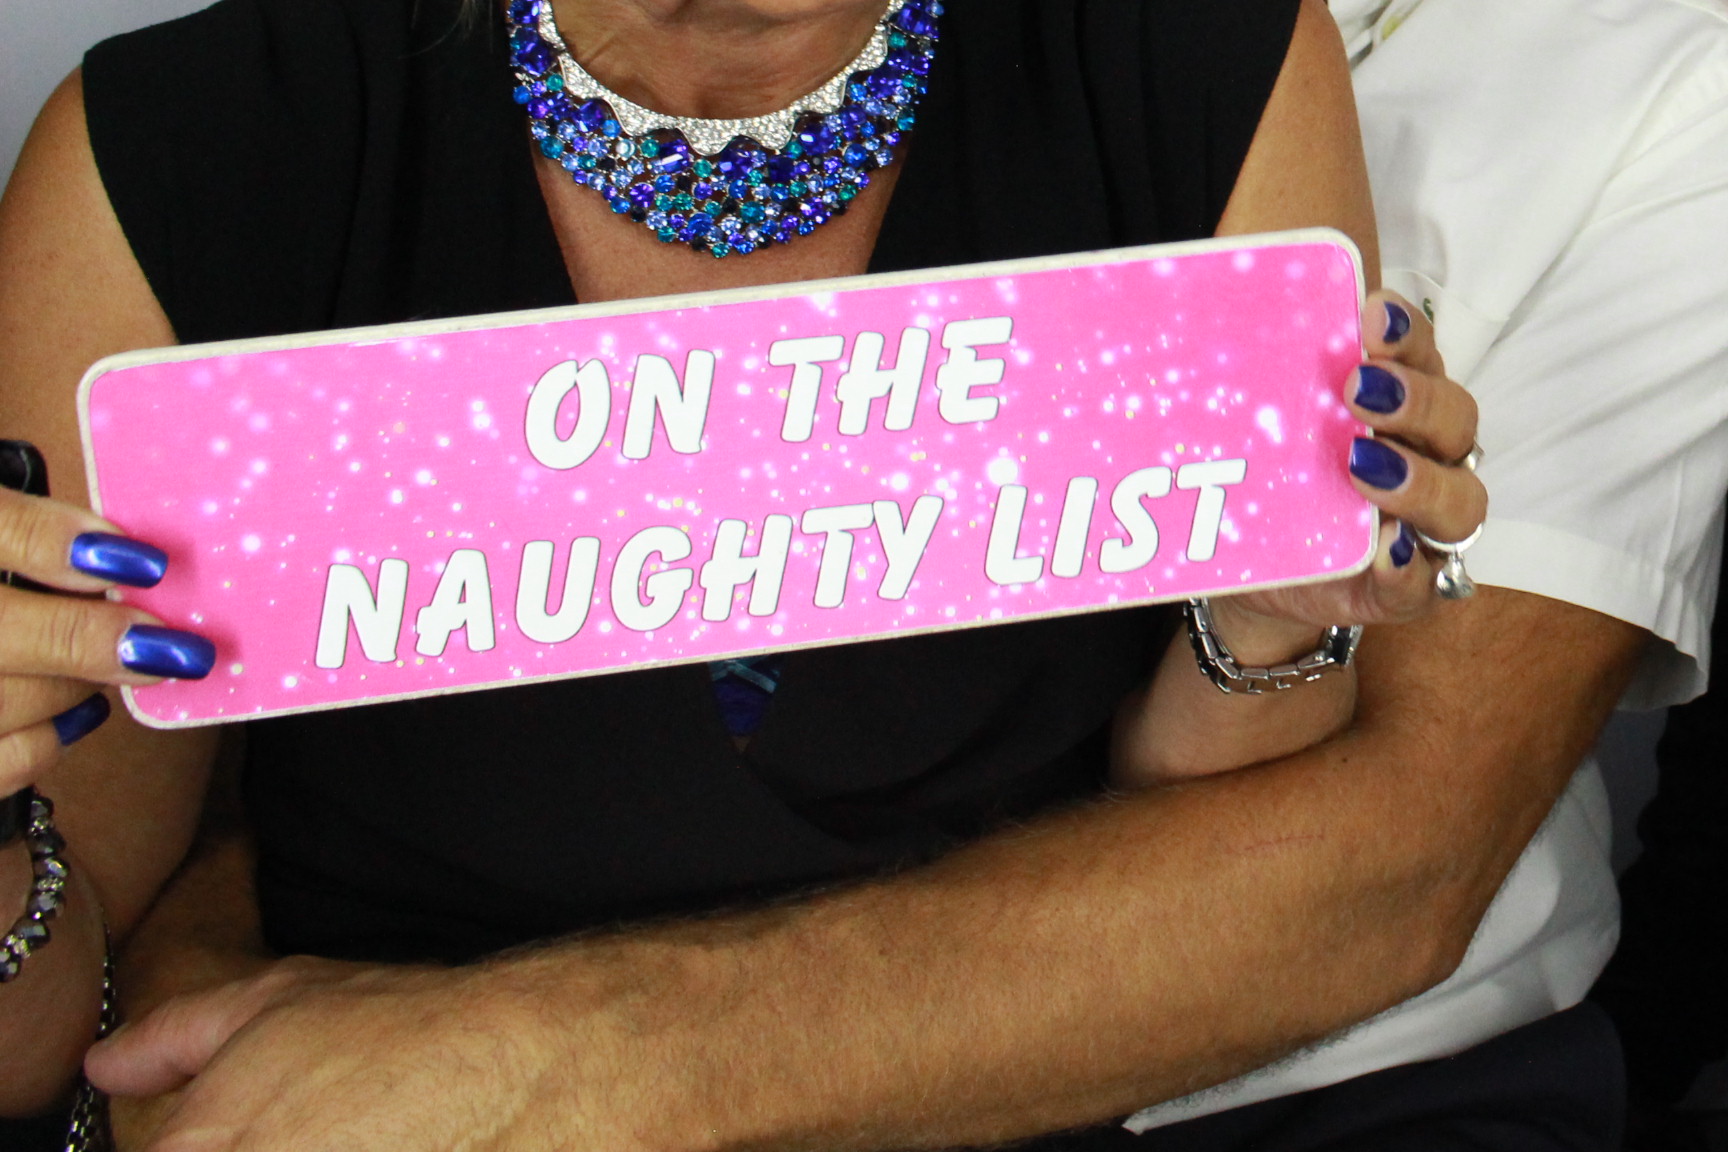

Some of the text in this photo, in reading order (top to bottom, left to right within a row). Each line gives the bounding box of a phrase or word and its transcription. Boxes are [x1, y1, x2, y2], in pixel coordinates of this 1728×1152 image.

[524, 316, 1013, 470] ON THE
[314, 458, 1247, 670] NAUGHTY LIST
